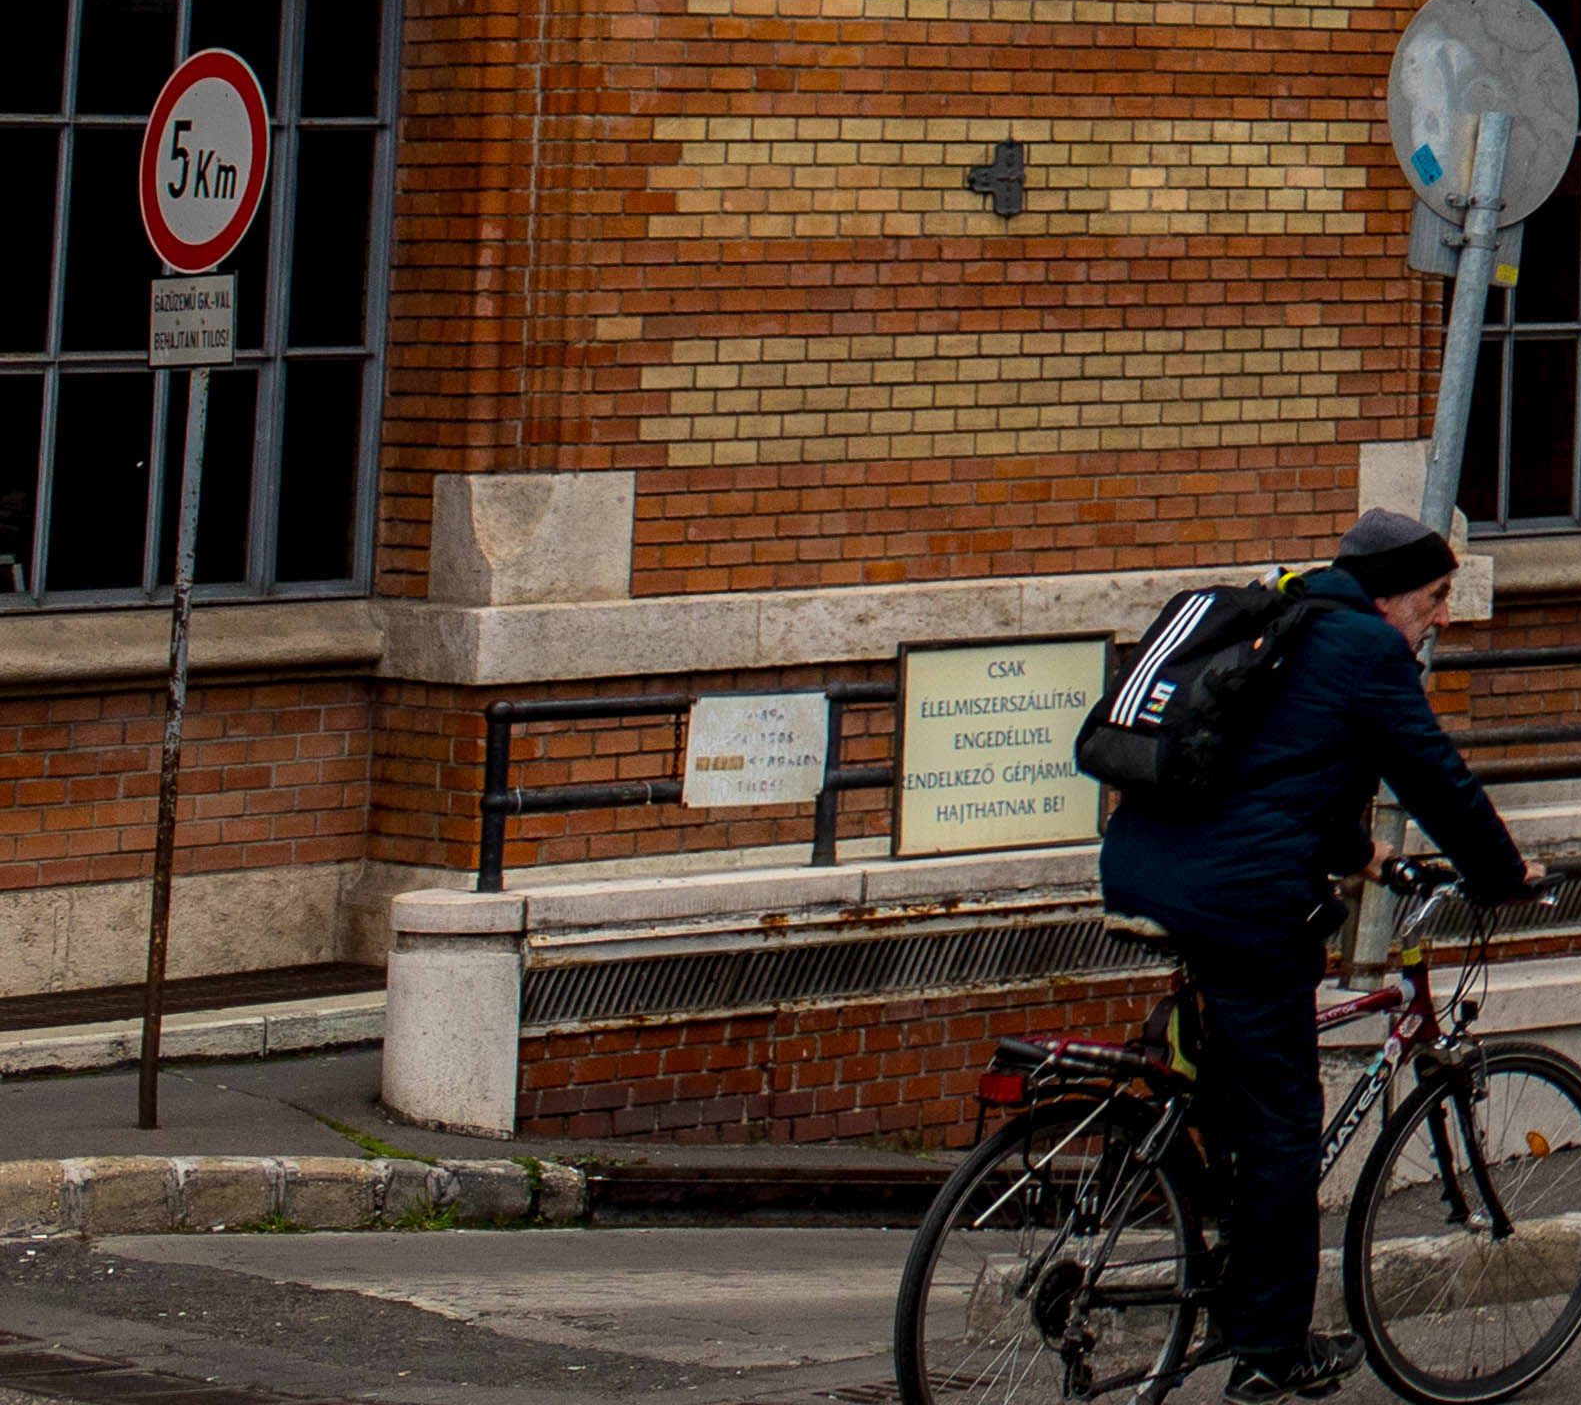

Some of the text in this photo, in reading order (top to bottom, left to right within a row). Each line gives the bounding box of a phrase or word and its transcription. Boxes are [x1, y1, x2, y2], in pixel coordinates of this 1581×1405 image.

[154, 328, 230, 351] BEHAJTANI TILOS!
[986, 660, 1026, 679] CSAK
[919, 686, 1087, 719] ÉLELMISZERSZÁLLÍTÁSI
[953, 724, 1053, 750] ENGEDÉLLYEL
[936, 795, 1066, 825] HAJTHATNAK BE!
